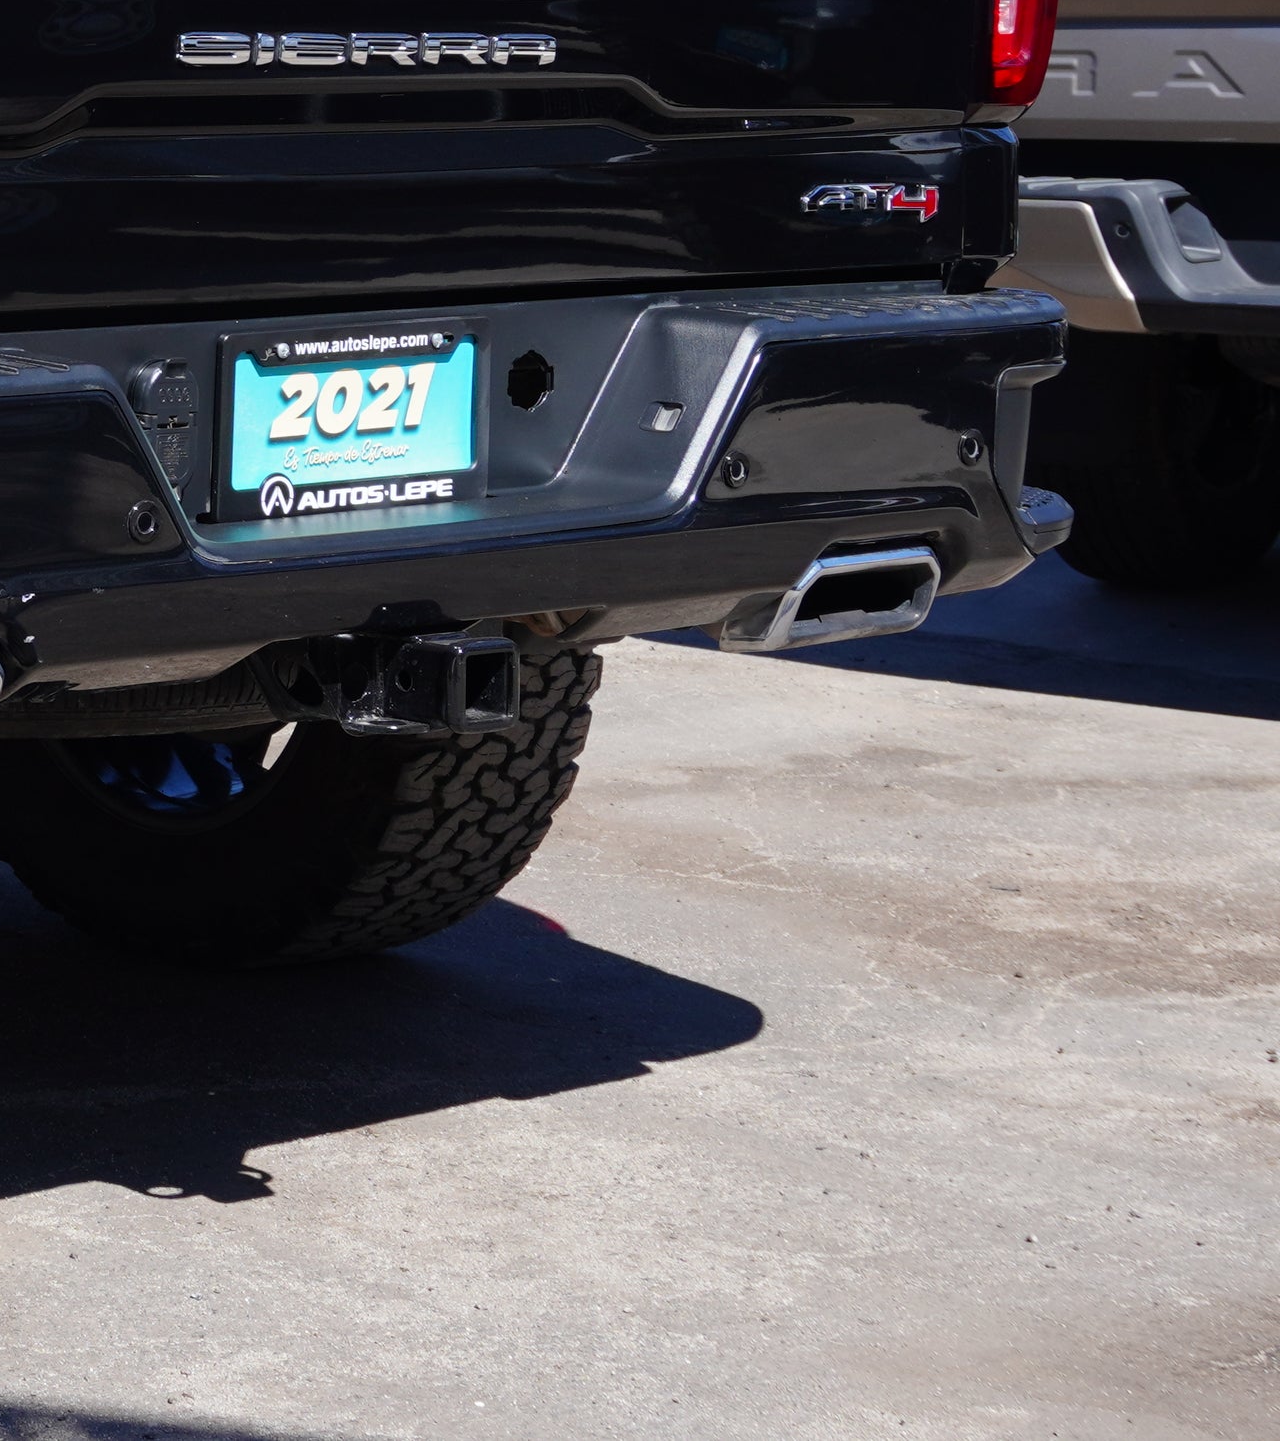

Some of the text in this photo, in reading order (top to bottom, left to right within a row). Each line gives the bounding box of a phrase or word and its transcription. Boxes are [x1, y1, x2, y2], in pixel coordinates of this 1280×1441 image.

[176, 32, 557, 66] SIERRA
[800, 183, 940, 223] AT4
[295, 333, 429, 356] www.autoslepe.com
[268, 362, 436, 440] 2021
[283, 439, 410, 472] Es Tiempo de Estrenar
